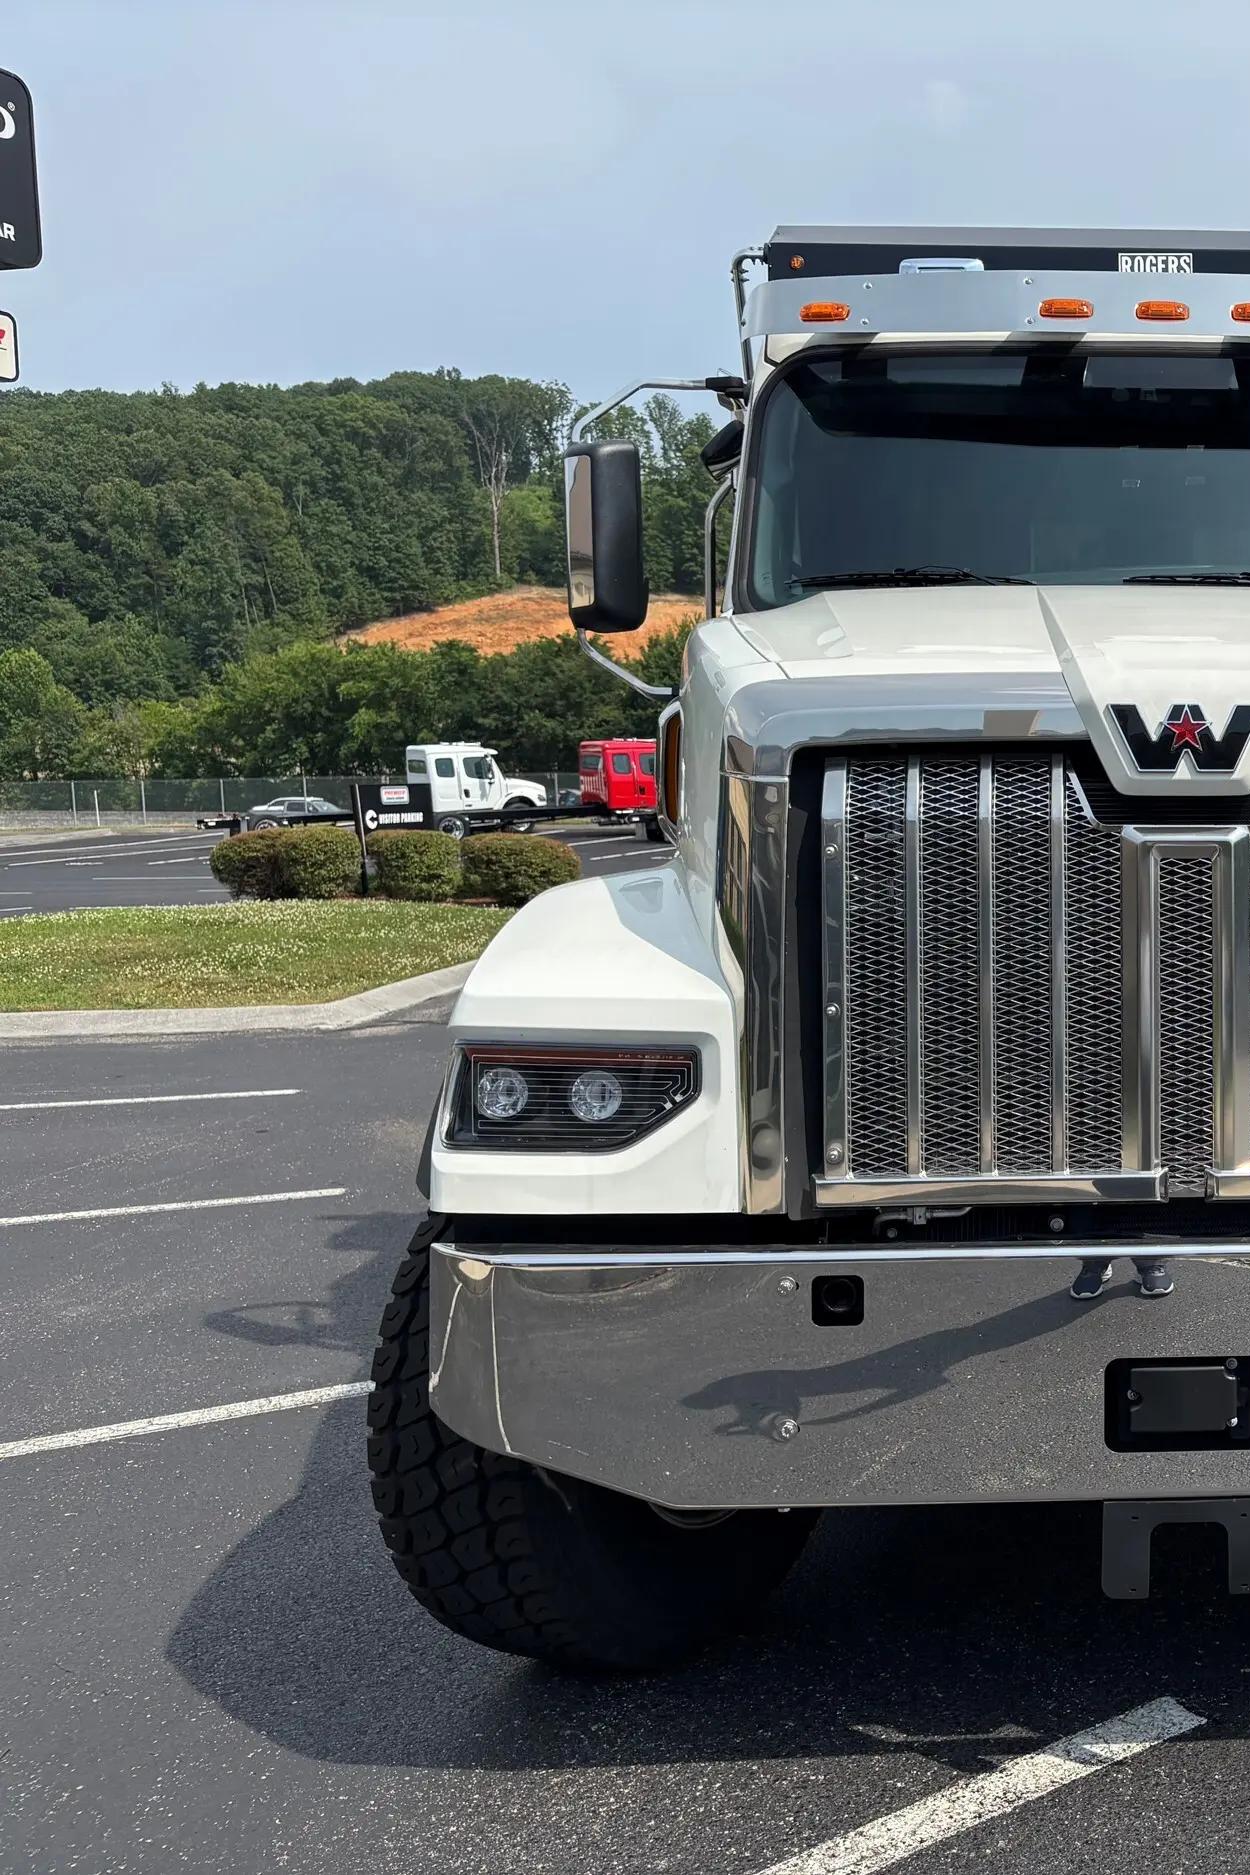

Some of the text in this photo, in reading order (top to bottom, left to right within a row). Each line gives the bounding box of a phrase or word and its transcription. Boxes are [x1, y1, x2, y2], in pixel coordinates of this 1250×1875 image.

[1121, 255, 1191, 274] ROGERS
[378, 811, 424, 825] VISITOR PARKING
